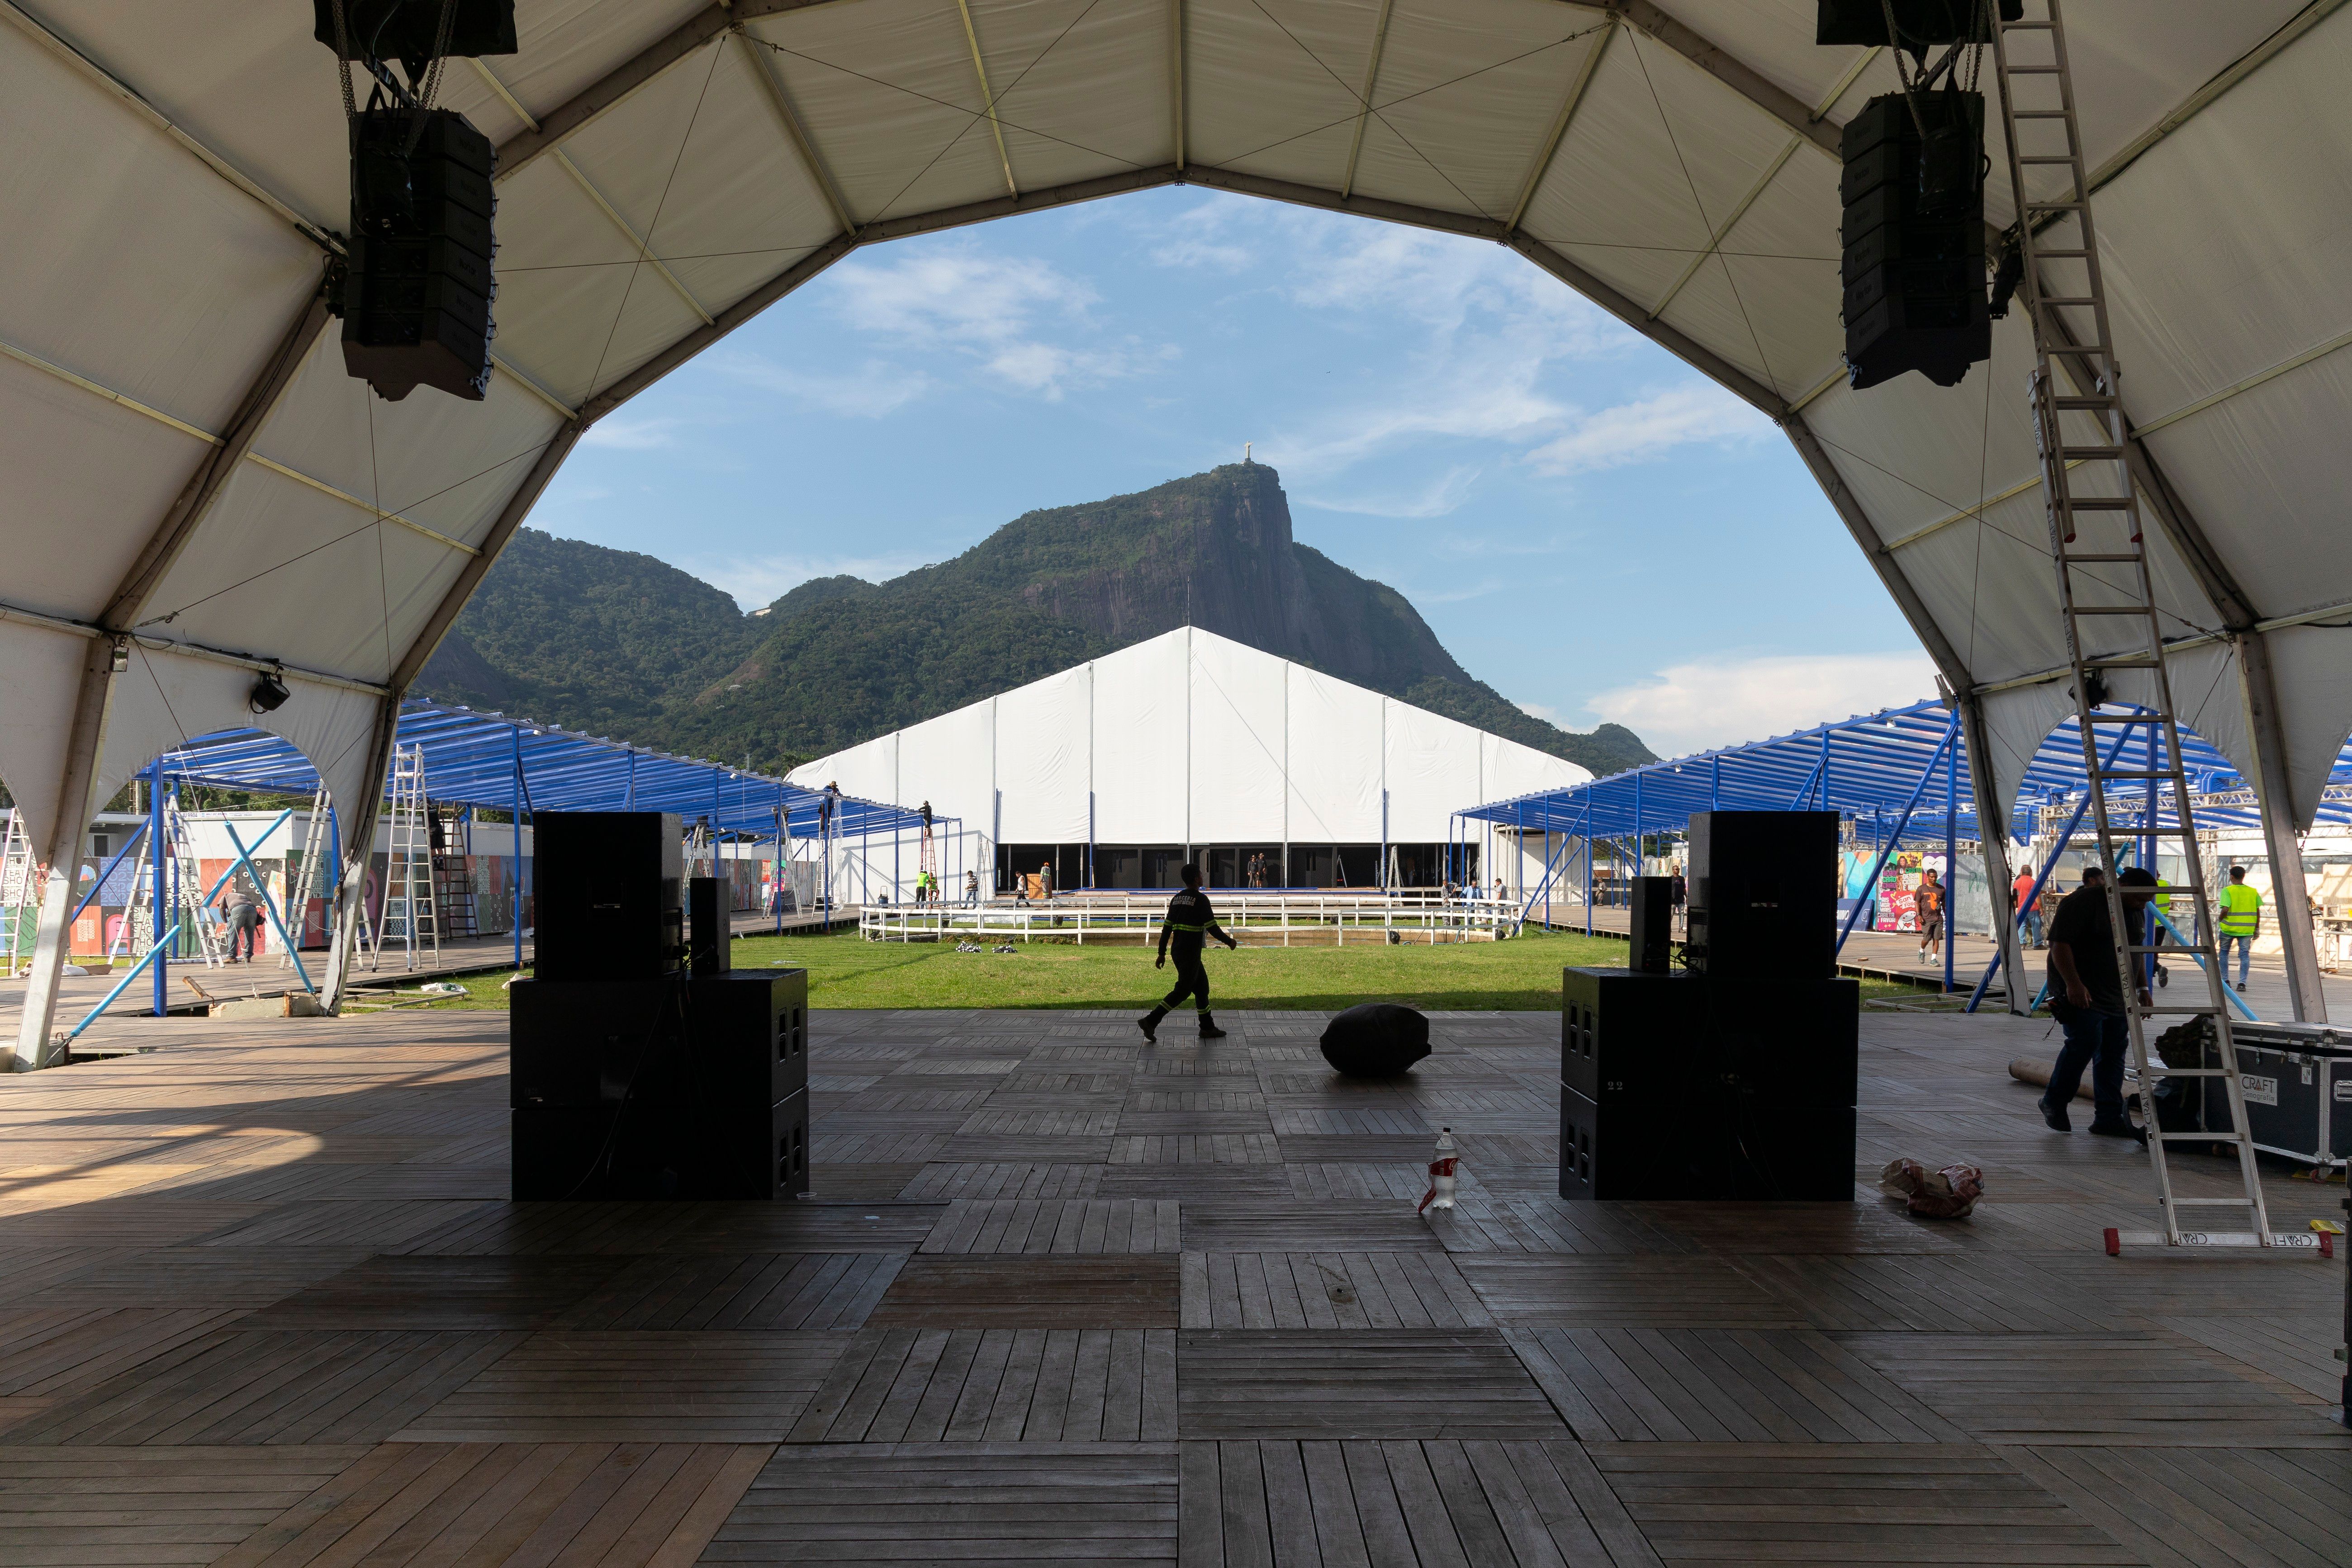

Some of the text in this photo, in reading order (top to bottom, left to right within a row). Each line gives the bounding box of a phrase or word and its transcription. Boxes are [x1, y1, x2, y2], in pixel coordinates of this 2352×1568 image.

[2242, 1076, 2274, 1093] CRAFT
[2140, 1087, 2151, 1125] CRAFT
[2178, 1233, 2207, 1244] CRAF
[2273, 1235, 2312, 1246] CRAFT
